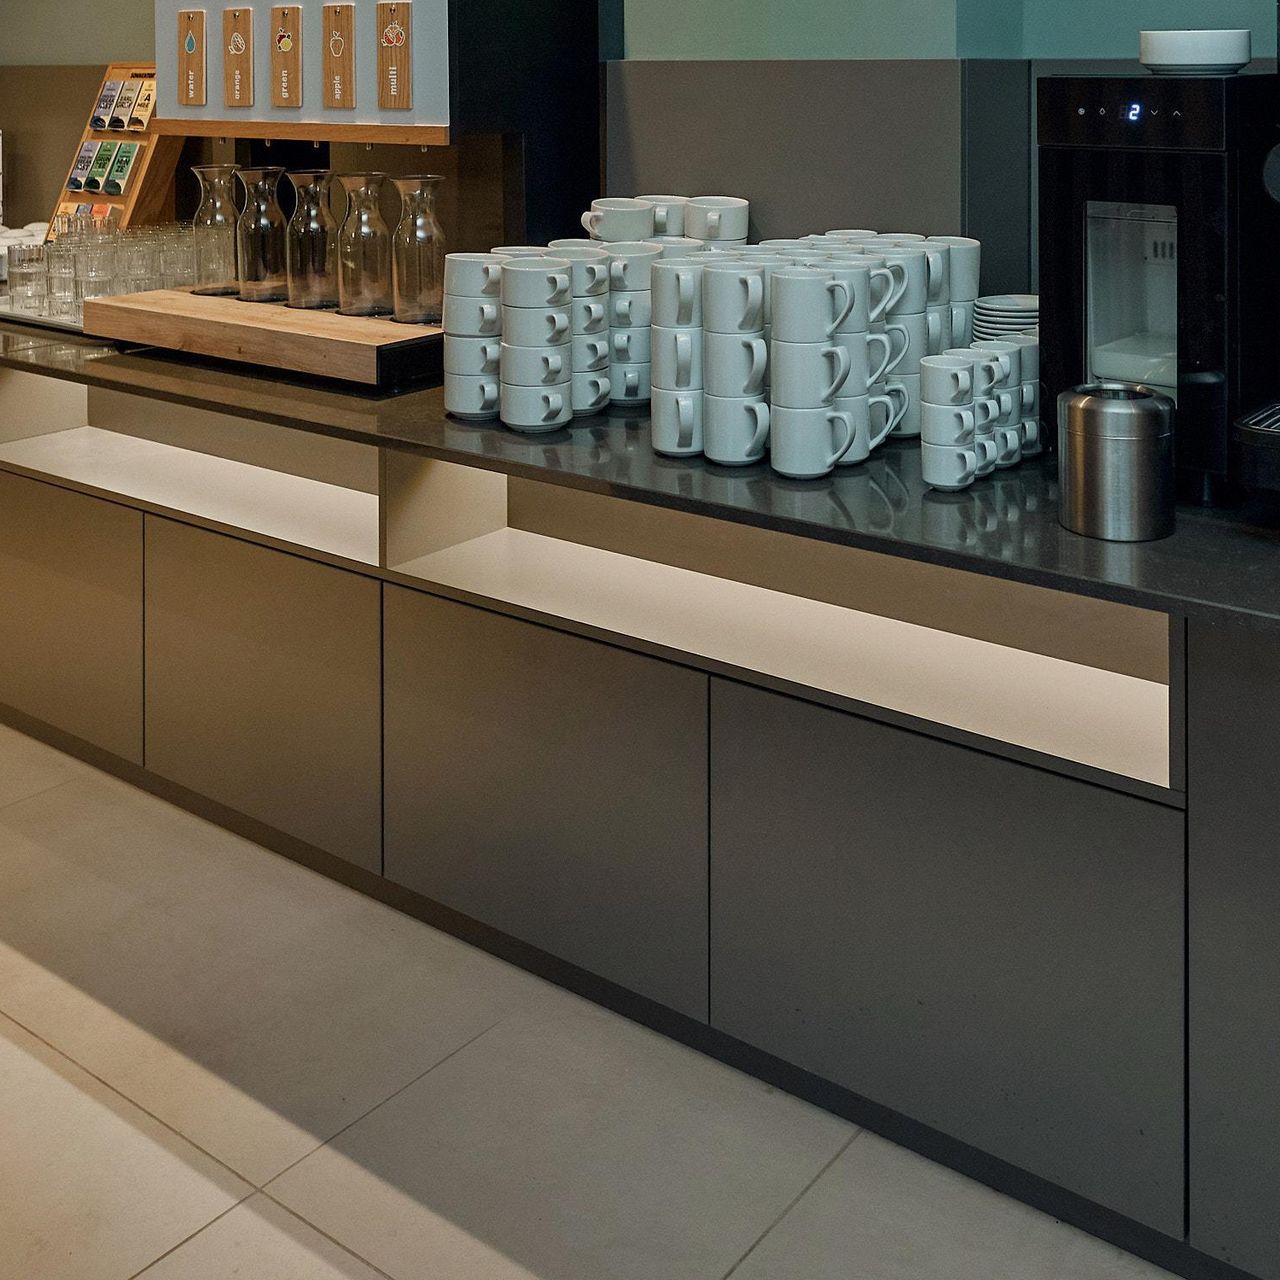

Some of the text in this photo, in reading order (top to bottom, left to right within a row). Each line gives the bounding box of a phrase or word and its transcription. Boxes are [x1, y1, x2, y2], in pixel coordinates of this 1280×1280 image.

[281, 69, 289, 99] green
[333, 75, 341, 100] apple
[388, 65, 397, 96] multi
[1129, 104, 1140, 120] 2
